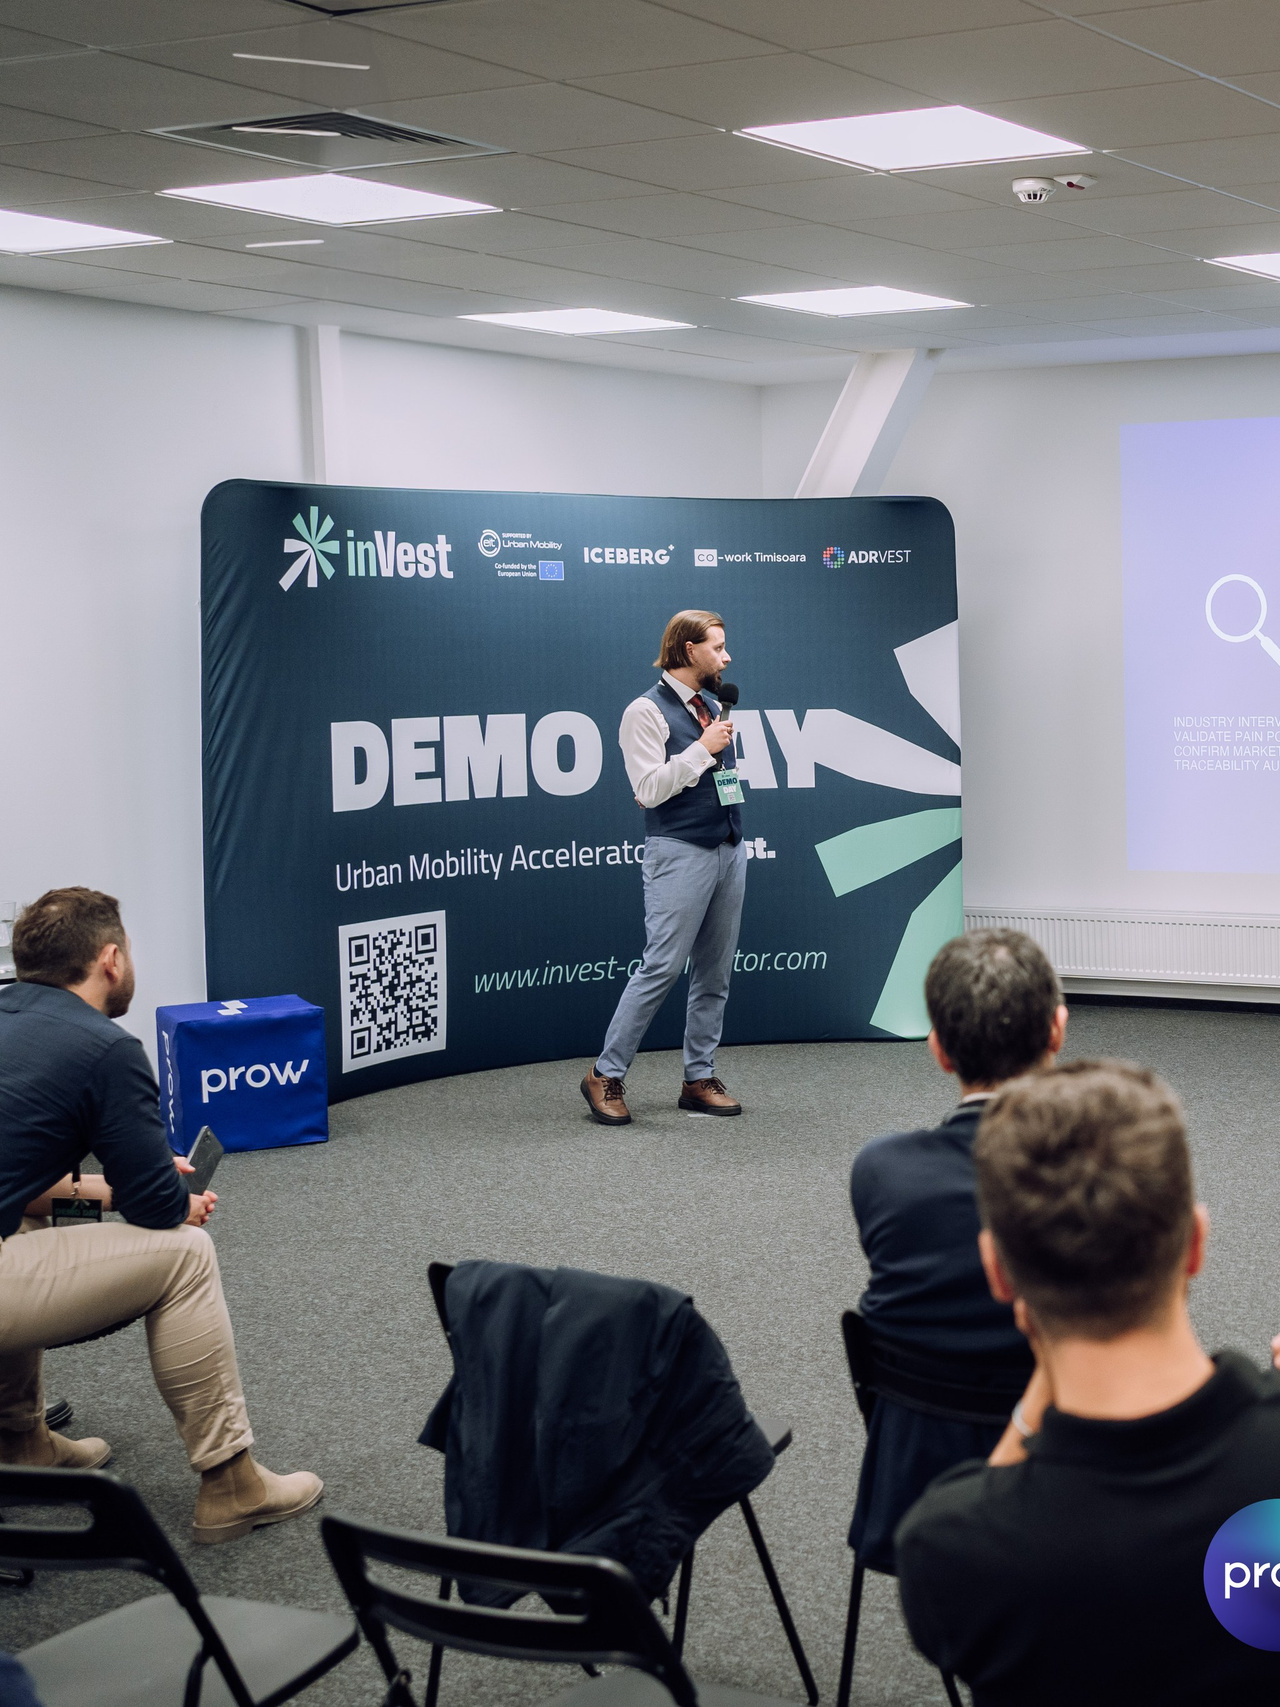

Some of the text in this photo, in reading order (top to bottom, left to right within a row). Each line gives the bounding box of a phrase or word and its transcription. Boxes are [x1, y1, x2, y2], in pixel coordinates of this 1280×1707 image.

[483, 538, 496, 547] eit
[502, 540, 563, 551] Urban Mobility
[347, 529, 454, 579] inVest
[754, 552, 807, 563] Timisoara
[847, 550, 912, 564] ADRVEST
[497, 570, 521, 578] European
[1174, 716, 1235, 728] INDUSTRY
[1174, 731, 1232, 742] VALIDATE
[1235, 731, 1263, 742] PAIN
[1174, 746, 1230, 757] CONFIRM
[330, 710, 604, 813] DEMO
[1174, 760, 1260, 771] TRACEABILITY
[717, 777, 738, 787] DEMO
[723, 785, 737, 794] DAY
[336, 840, 646, 892] Urban Mobility Accelerato
[162, 1029, 175, 1134] prow
[201, 1059, 310, 1103] prow
